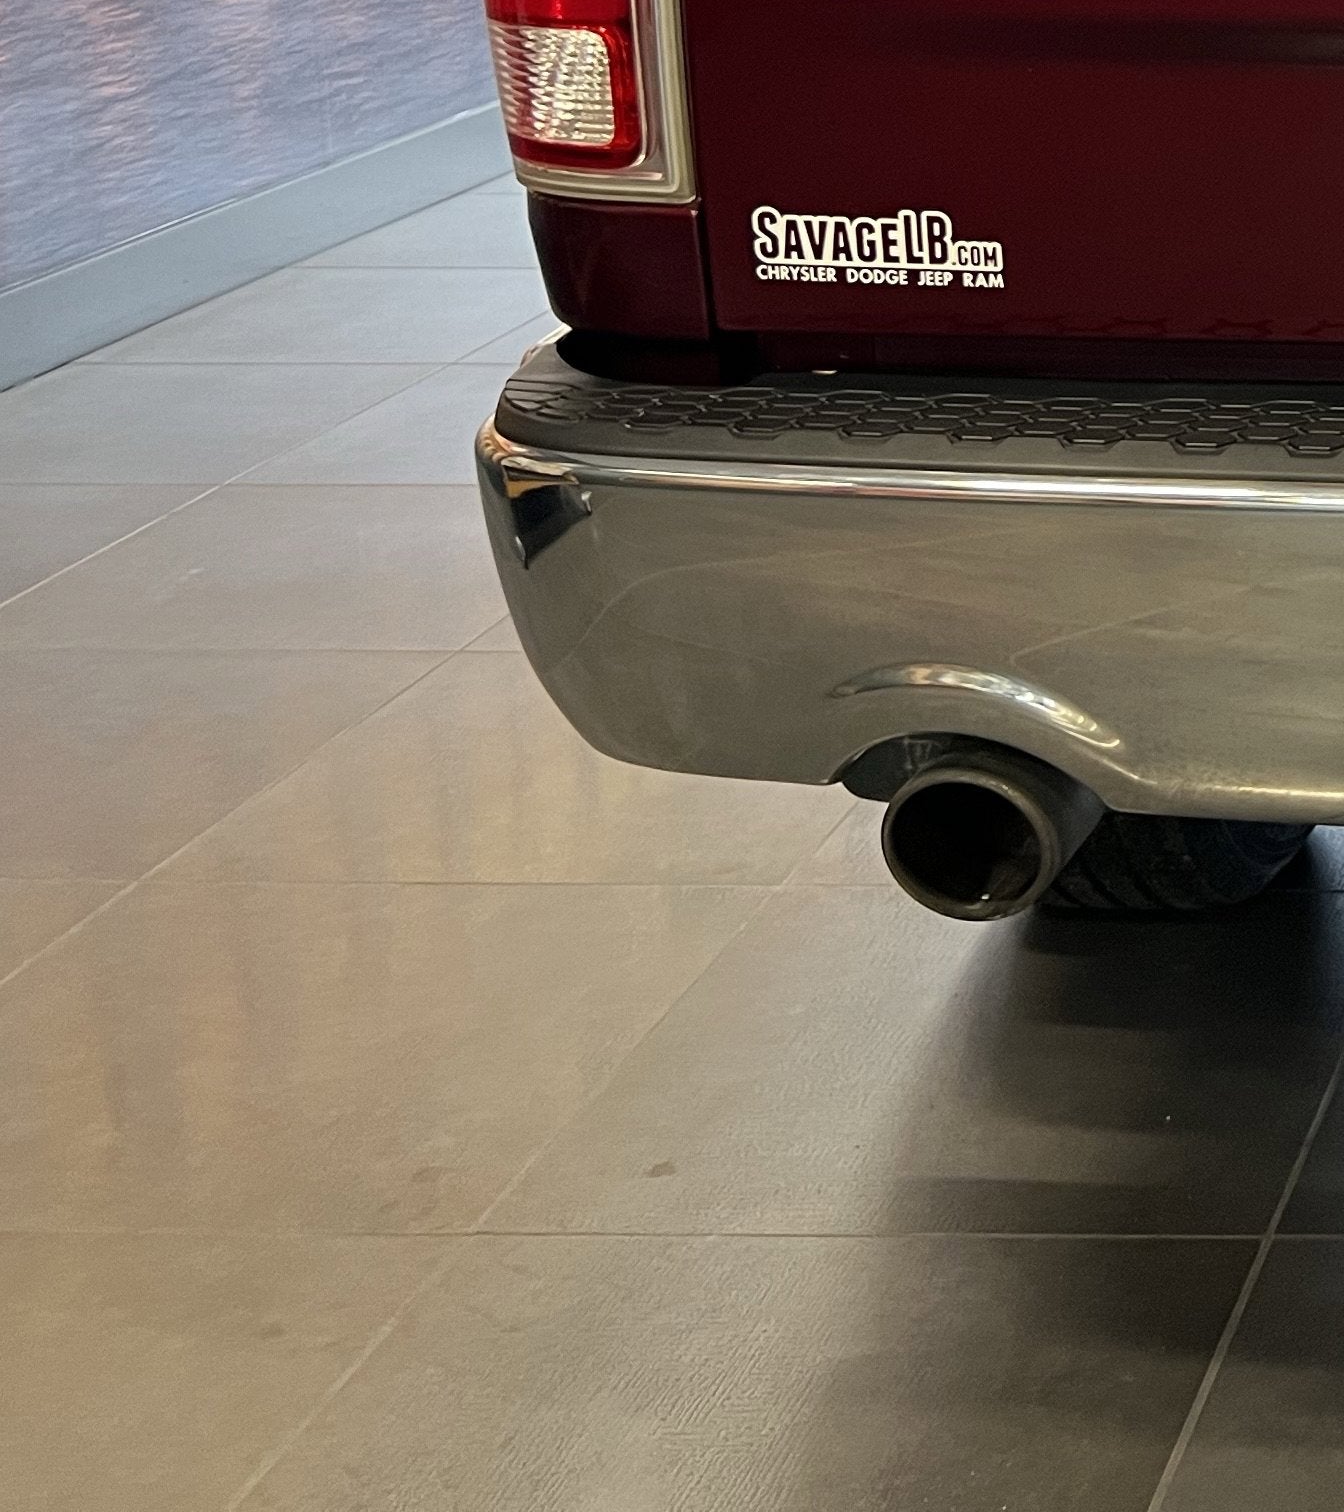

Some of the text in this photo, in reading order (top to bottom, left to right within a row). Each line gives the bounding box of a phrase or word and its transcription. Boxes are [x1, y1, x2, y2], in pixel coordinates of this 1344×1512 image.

[755, 265, 1004, 288] CHRYSLER DODGE JEEP RAM
